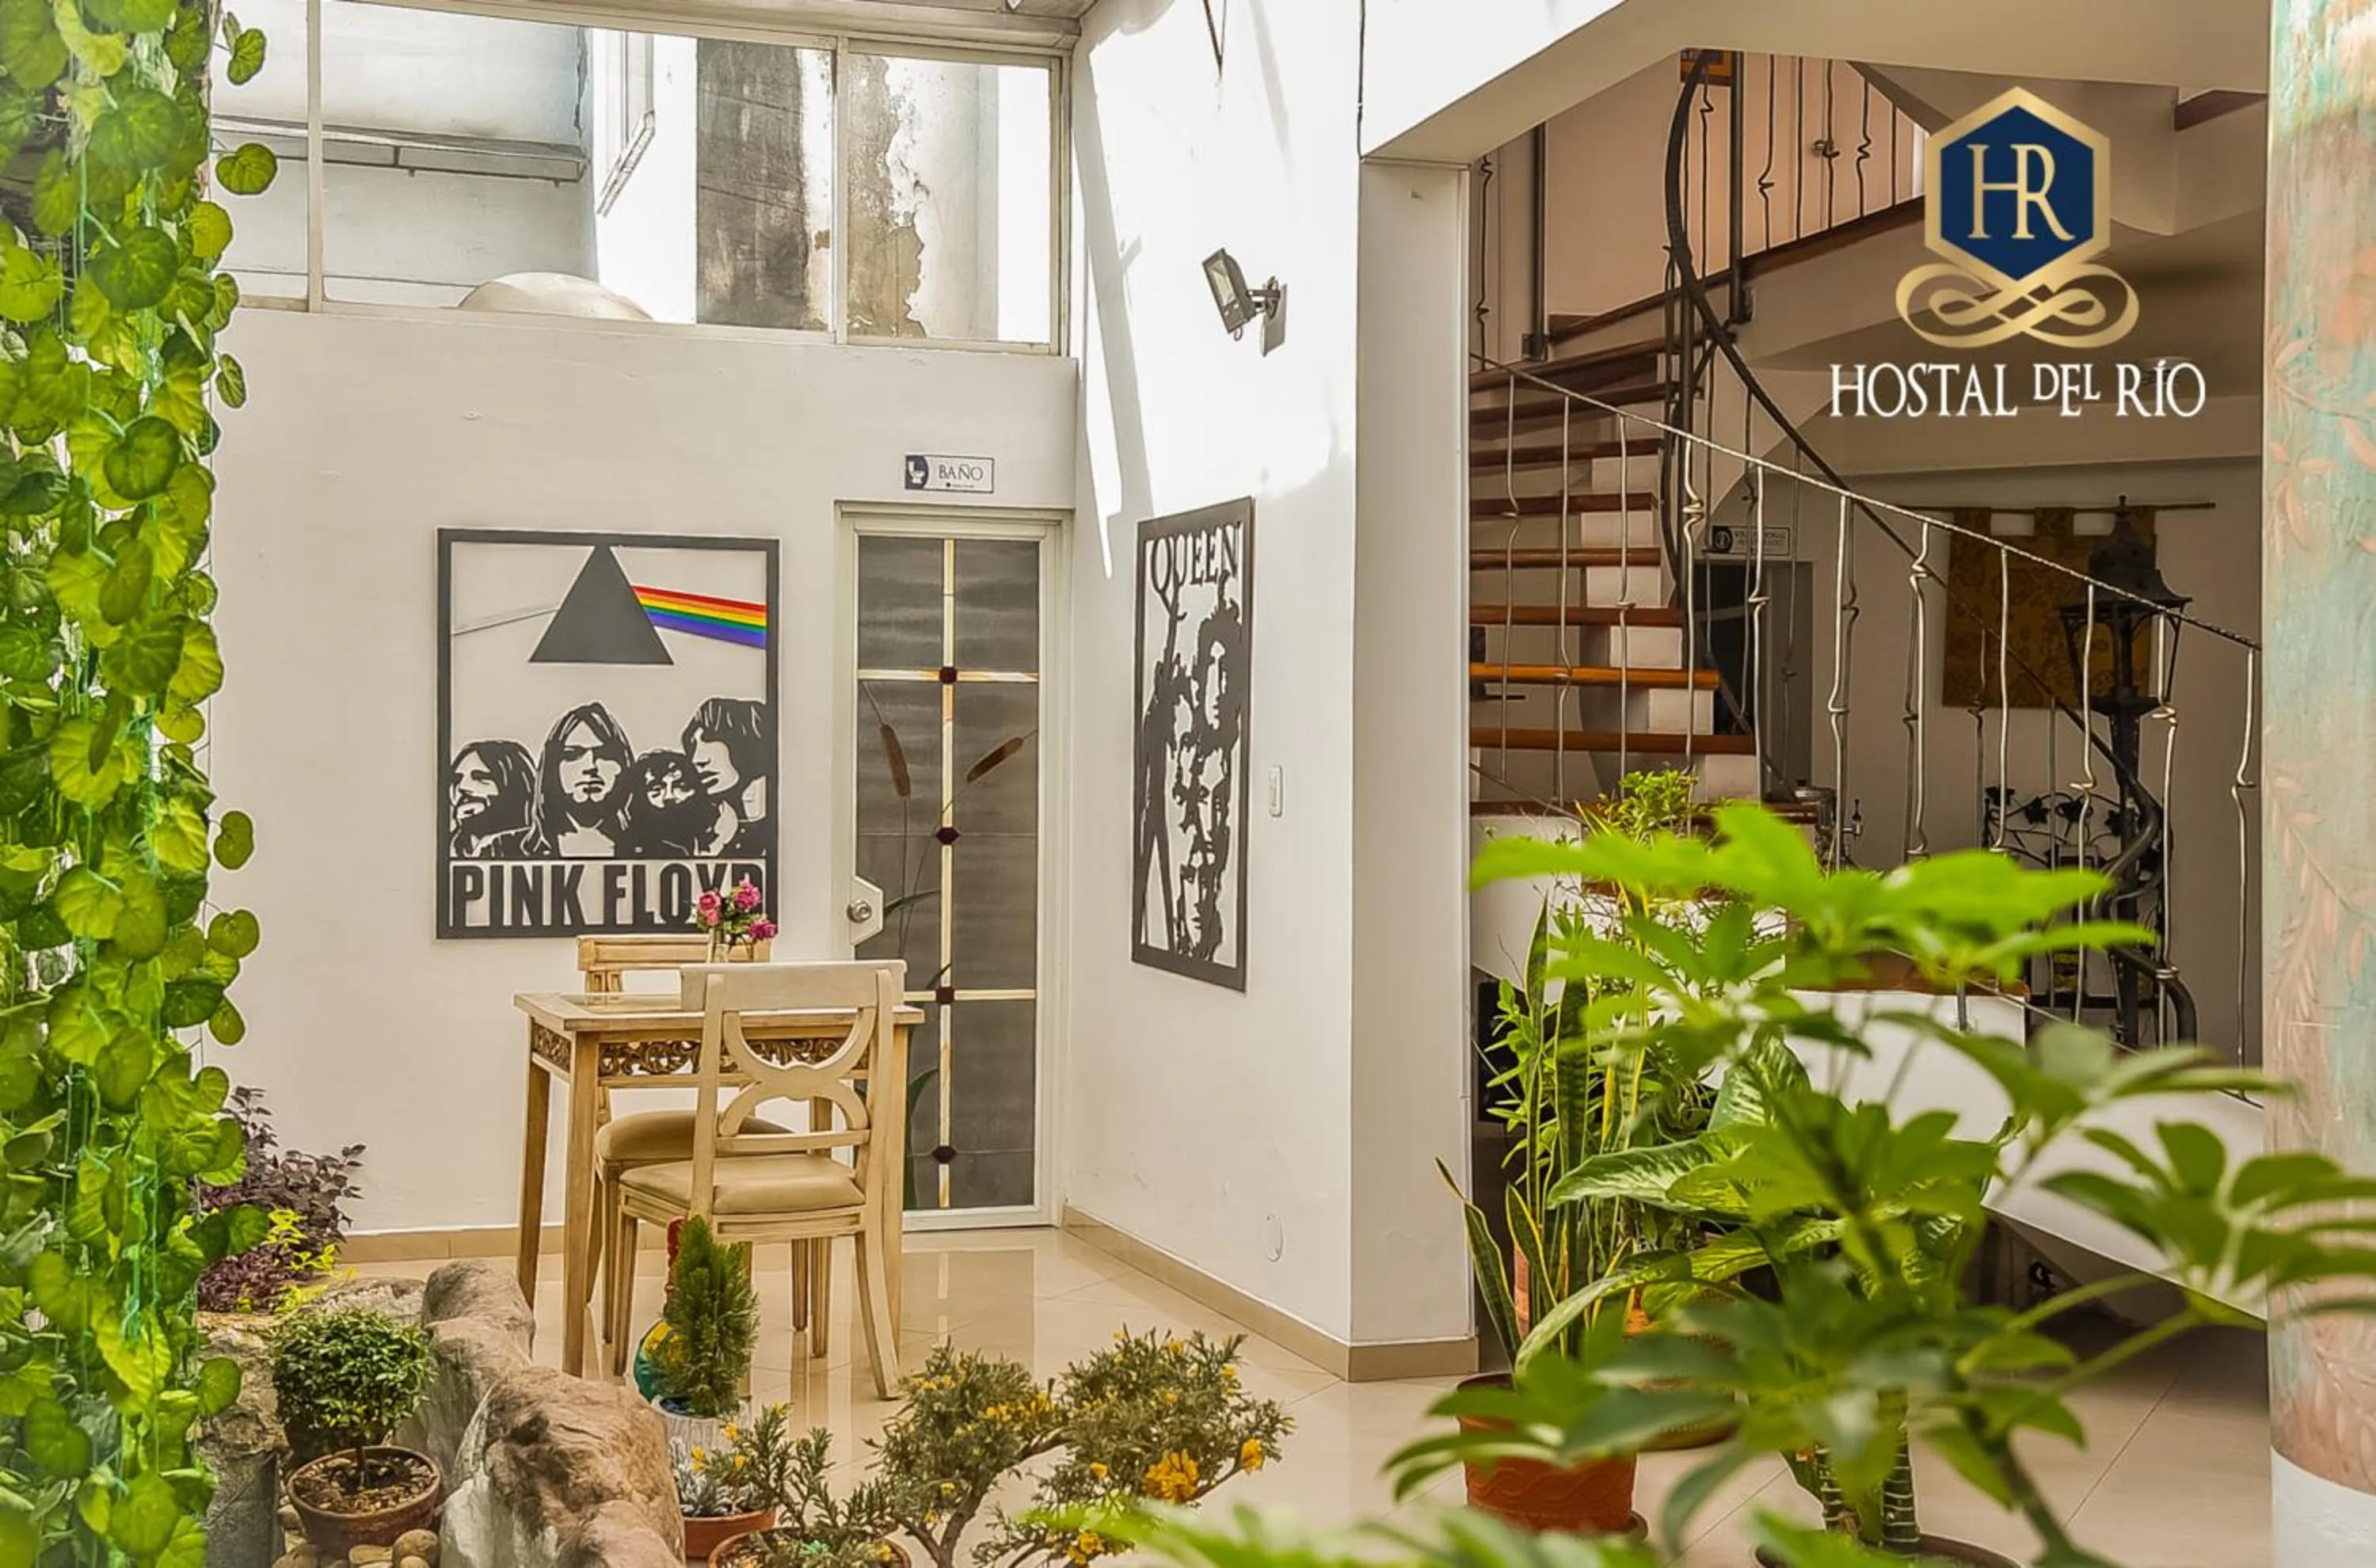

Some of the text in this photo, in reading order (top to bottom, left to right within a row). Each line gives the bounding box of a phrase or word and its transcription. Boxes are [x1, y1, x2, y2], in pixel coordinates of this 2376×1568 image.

[938, 463, 984, 481] BAÑO
[1151, 520, 1241, 621] QUEEN
[452, 863, 586, 927] PINK
